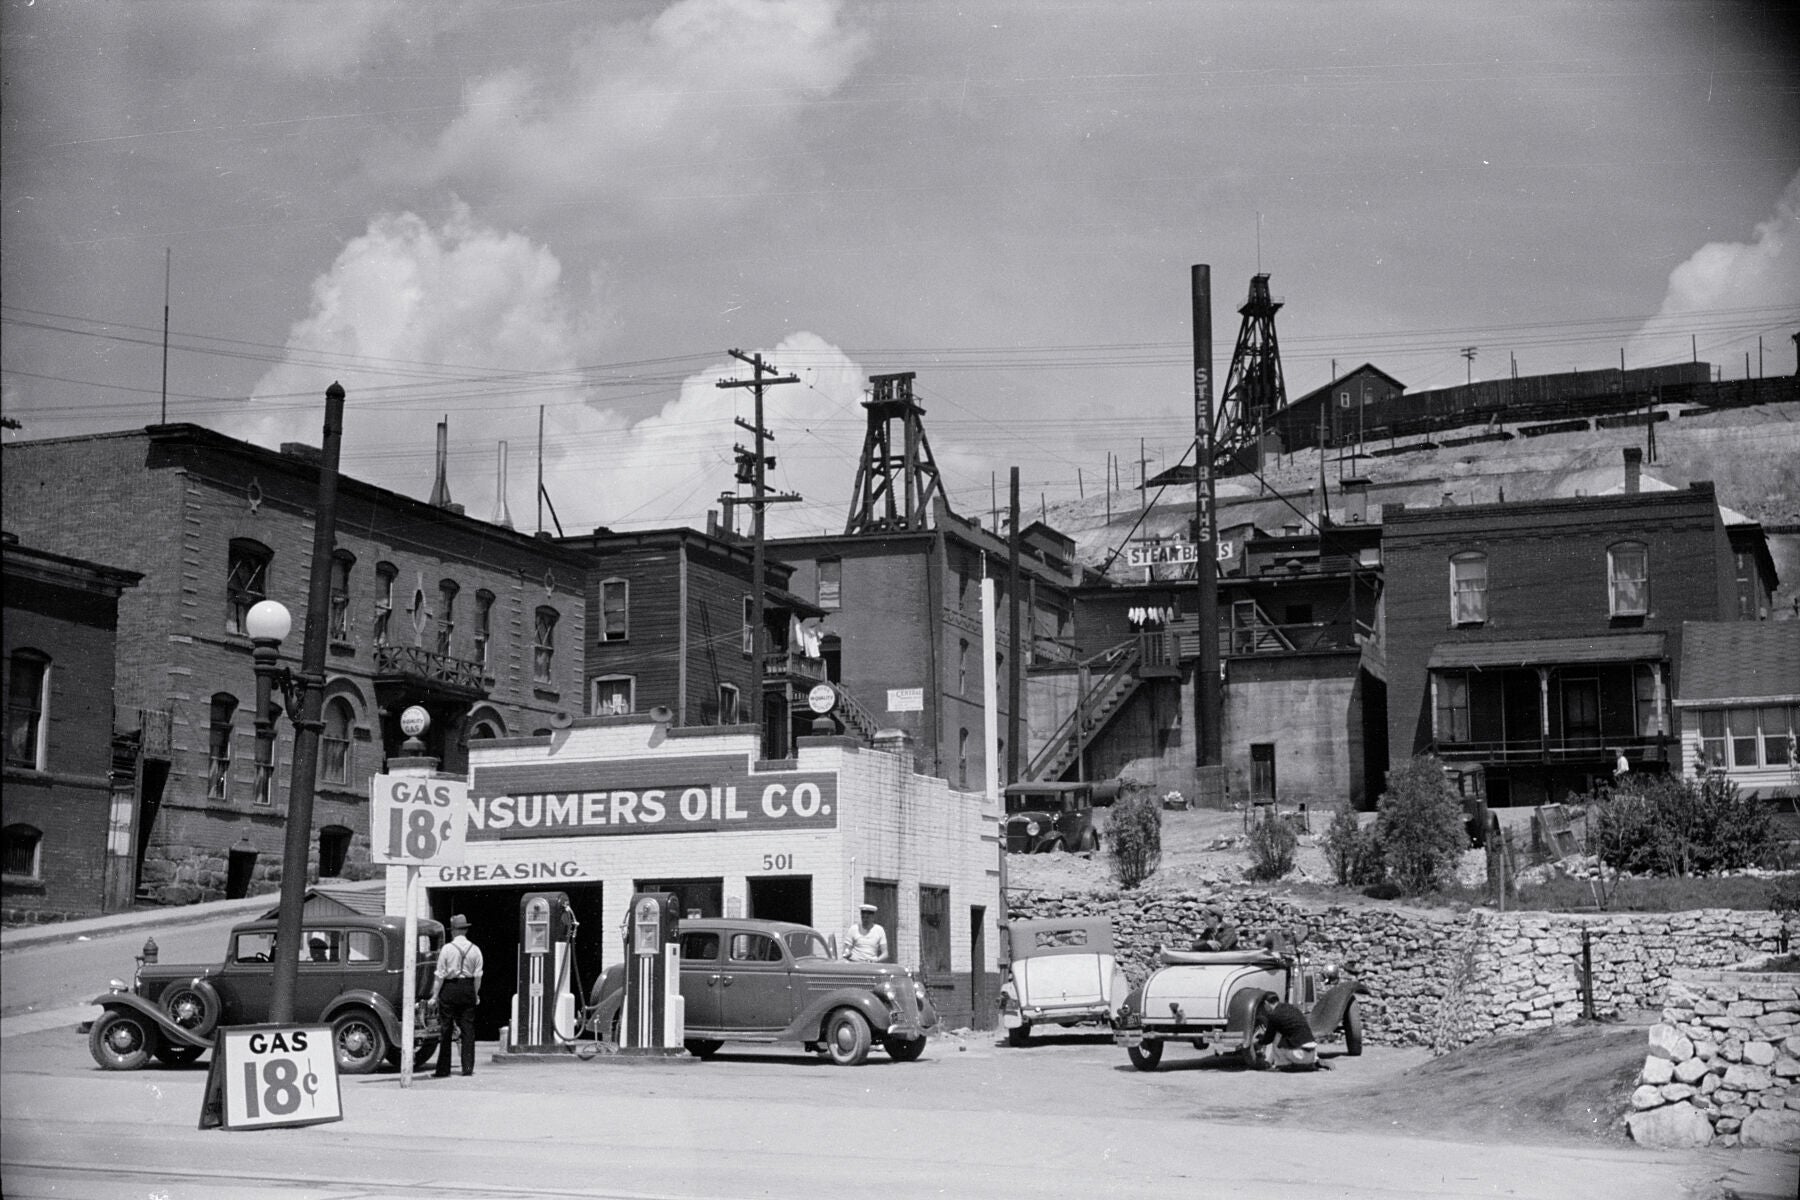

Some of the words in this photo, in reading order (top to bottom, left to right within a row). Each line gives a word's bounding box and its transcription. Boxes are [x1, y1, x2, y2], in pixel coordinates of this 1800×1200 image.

[1196, 368, 1209, 449] STEAM
[1198, 466, 1211, 542] BATHS
[1132, 545, 1179, 564] STEAM
[1183, 544, 1229, 561] BAS
[391, 782, 450, 807] GAS
[680, 788, 748, 821] OIL
[762, 783, 831, 818] CO.
[389, 808, 453, 859] 18¢
[763, 854, 793, 870] 501
[249, 1031, 308, 1054] GAS
[244, 1058, 319, 1118] 18¢
